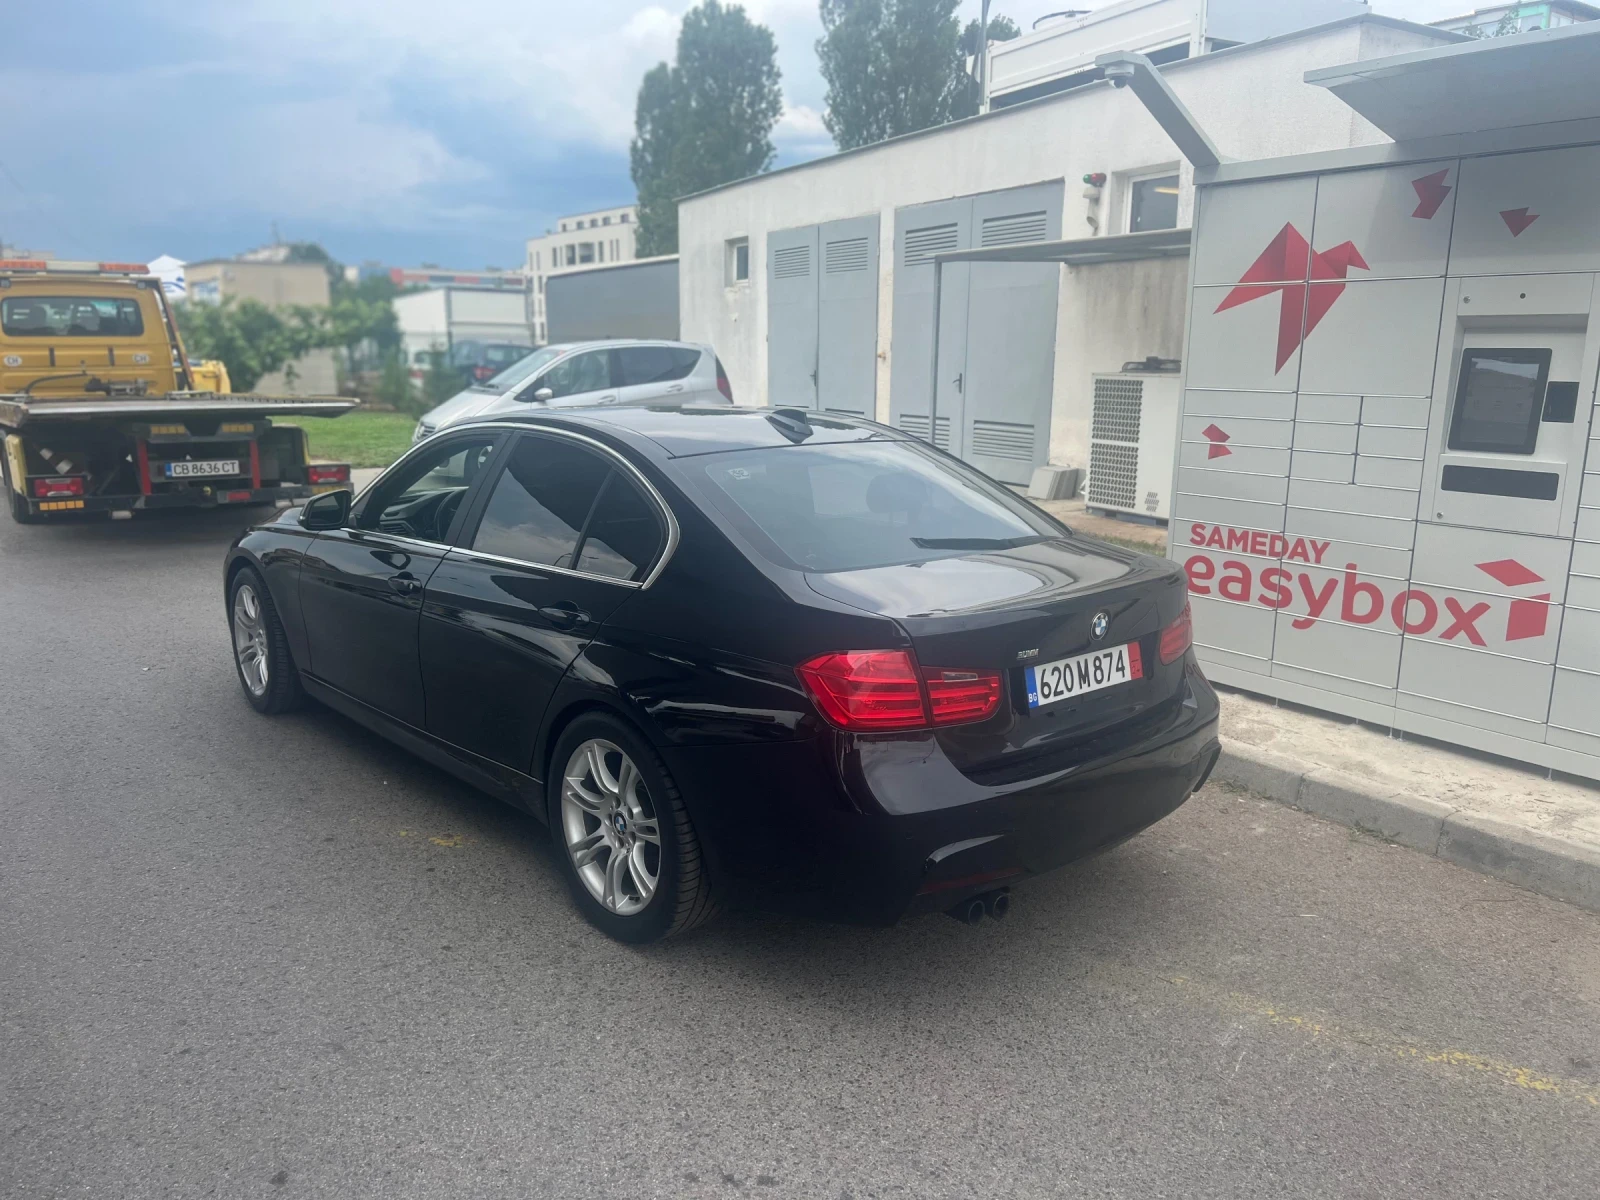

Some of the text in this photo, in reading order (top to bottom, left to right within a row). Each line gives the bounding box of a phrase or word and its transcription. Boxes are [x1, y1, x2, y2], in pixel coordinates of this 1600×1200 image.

[173, 464, 189, 475] CB
[192, 463, 220, 474] 8636
[222, 462, 236, 473] CT
[1190, 523, 1331, 564] SAMEDAY
[1183, 554, 1491, 647] easybox
[1028, 692, 1038, 703] BG
